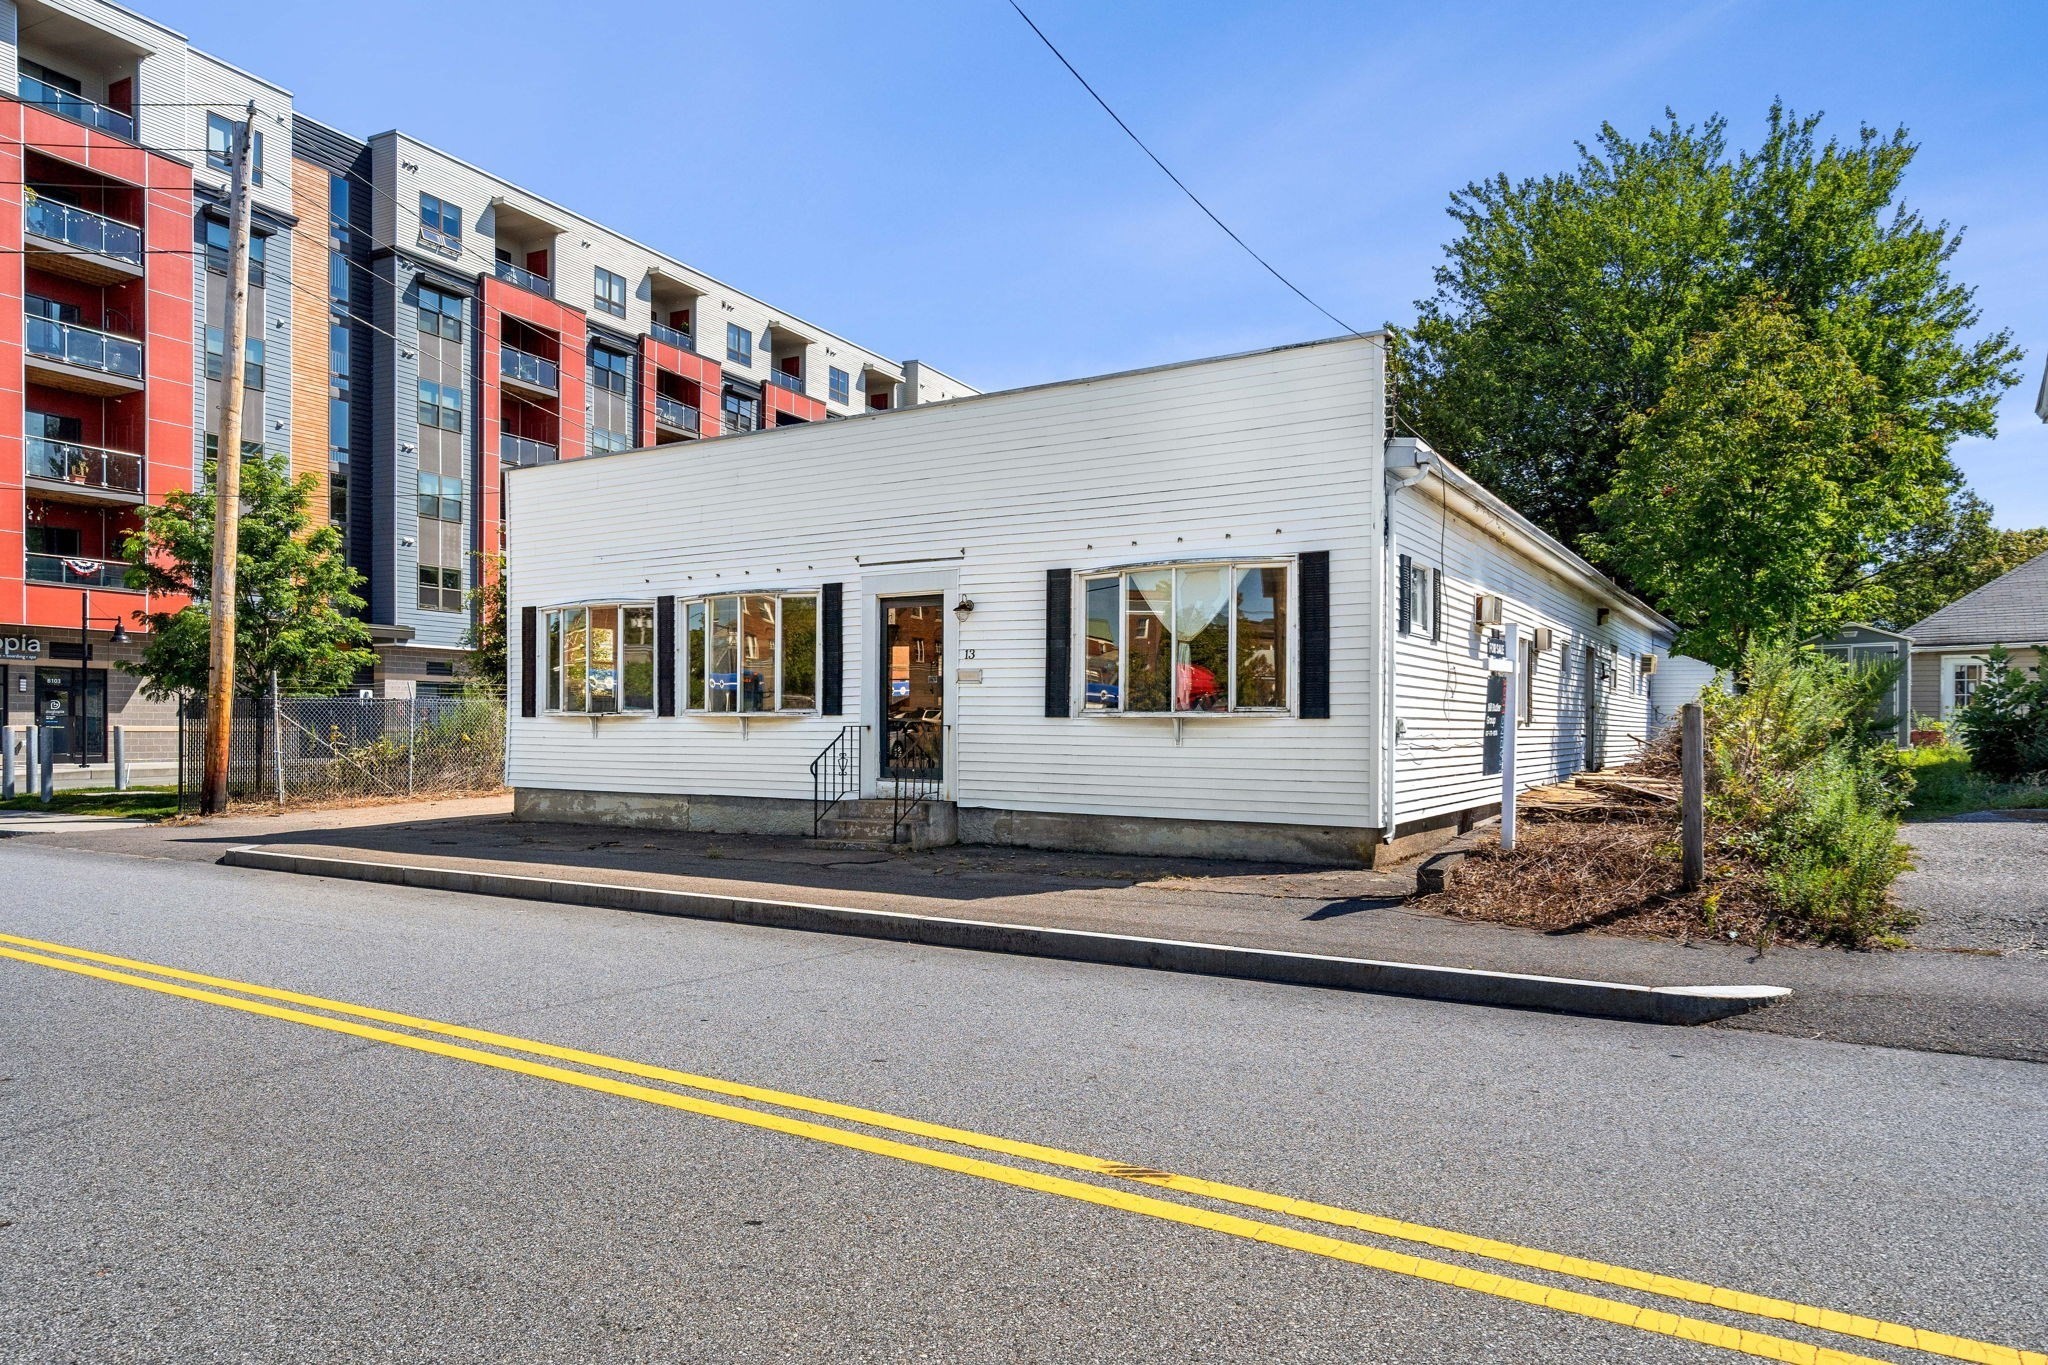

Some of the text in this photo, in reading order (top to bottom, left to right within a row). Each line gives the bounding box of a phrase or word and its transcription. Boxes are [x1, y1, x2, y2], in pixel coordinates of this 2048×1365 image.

[0, 634, 40, 655] pia
[1496, 643, 1505, 655] SALE
[965, 649, 975, 659] 13
